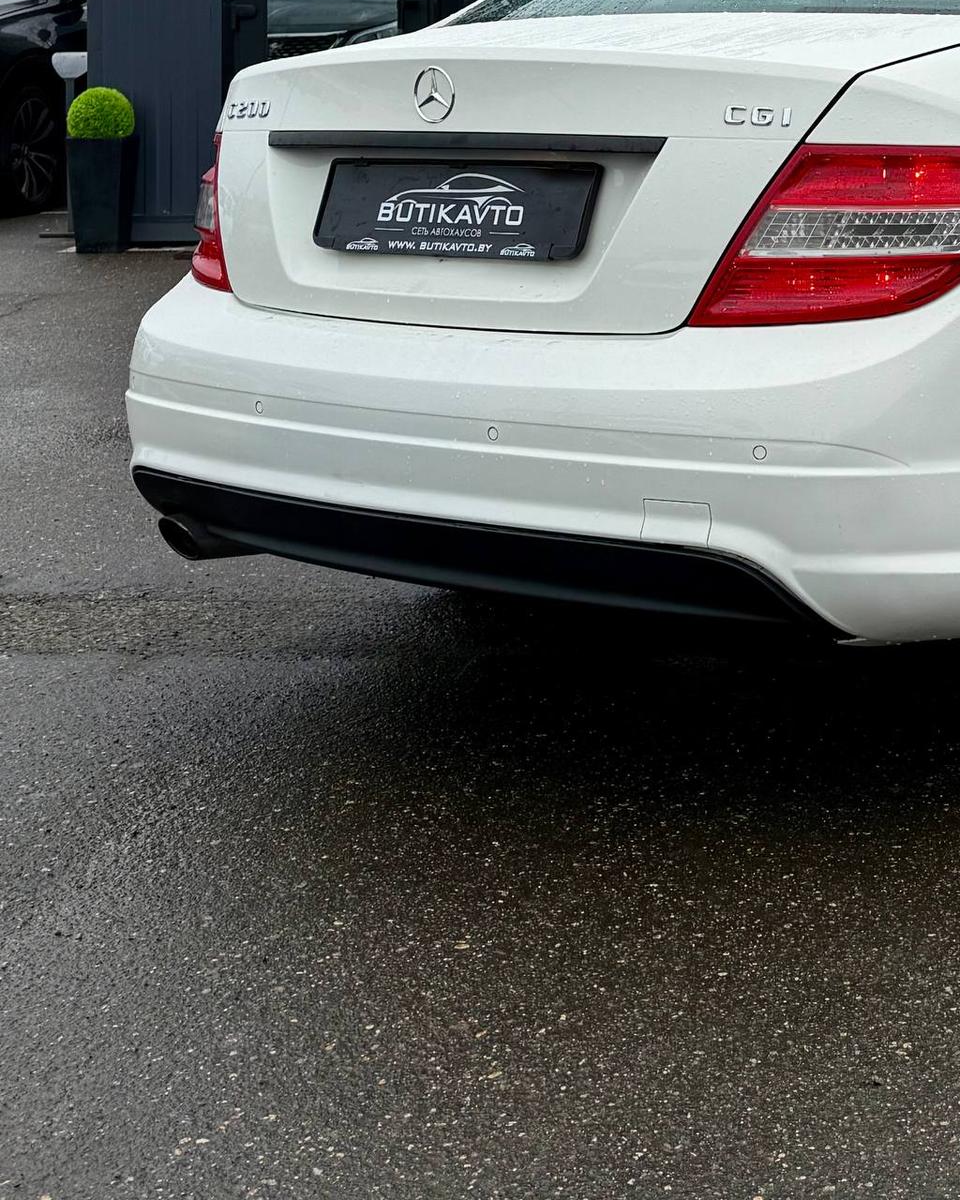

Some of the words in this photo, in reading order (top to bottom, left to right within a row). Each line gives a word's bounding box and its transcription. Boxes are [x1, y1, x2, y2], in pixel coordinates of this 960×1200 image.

[724, 105, 792, 127] CGI
[376, 201, 524, 227] BUTIKAVTO
[411, 226, 429, 237] СЕТЬ
[430, 228, 482, 238] АВТОХАУСОВ
[388, 240, 416, 250] WWW.
[419, 242, 493, 253] BUTIKAVTO.BY
